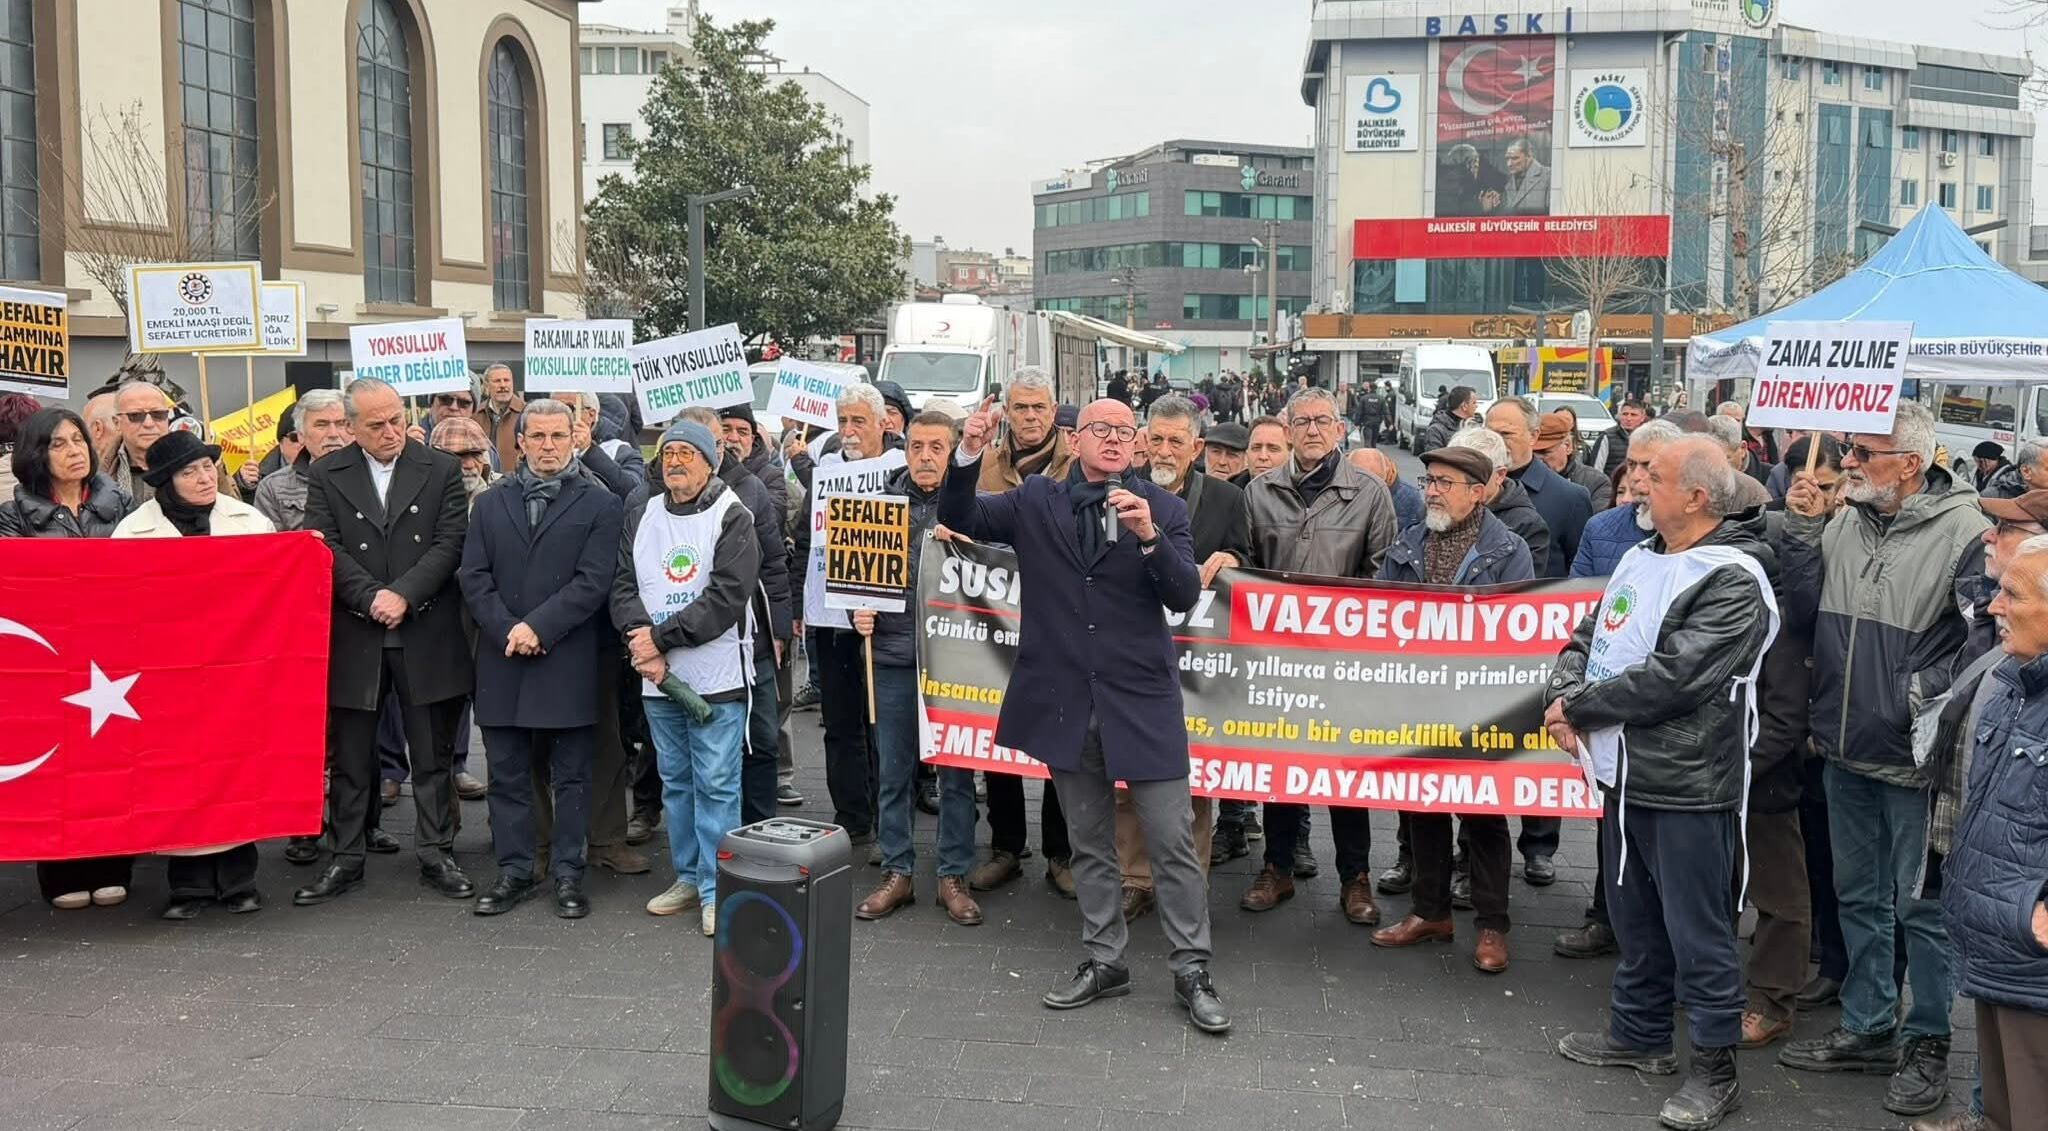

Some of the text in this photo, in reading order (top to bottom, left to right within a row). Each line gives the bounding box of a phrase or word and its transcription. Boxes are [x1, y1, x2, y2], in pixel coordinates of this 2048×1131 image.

[1425, 6, 1573, 36] BASKİ
[1427, 218, 1598, 234] BALIKESİR BÜYÜKŞEHİR BELEDİYESİ
[146, 318, 184, 329] EMEKLİ
[186, 316, 222, 329] MAAŞI
[172, 306, 222, 318] 20,000 TL
[264, 314, 290, 324] ORUZ
[147, 330, 191, 341] SEFALET
[368, 332, 448, 357] YOKSULLUK
[533, 330, 625, 349] RAKAMLAR YALAN
[632, 337, 743, 384] TÜİK YOKSULLUĞA
[1766, 339, 1822, 368] ZAMA
[1826, 340, 1899, 369] ZULME
[1960, 339, 2042, 358] BÜYÜKŞEHİR
[405, 354, 465, 383] DEĞİLDİR
[527, 356, 631, 381] YOKSULLUK GERÇEK
[777, 369, 802, 390] HAK
[646, 370, 743, 411] FENER TUTUYOR
[1756, 375, 1894, 413] DİRENİYORUZ
[792, 396, 829, 418] ALINIR
[829, 498, 906, 527] SEFALET
[830, 526, 904, 551] ZAMMINA
[828, 548, 904, 586] HAYIR
[665, 591, 697, 605] 2021
[925, 615, 988, 641] Çünkü
[1178, 650, 1239, 678] değil,
[1246, 656, 1326, 680] yıllarca
[1333, 660, 1448, 685] ödedikleri
[1247, 685, 1326, 709] istiyor.
[920, 667, 1002, 704] İnsanca
[1222, 717, 1299, 740] onurlu
[1307, 718, 1341, 743] bir
[1348, 722, 1463, 749] emeklilik
[1471, 723, 1514, 753] için
[1285, 767, 1500, 808] DAYANIŞMA
